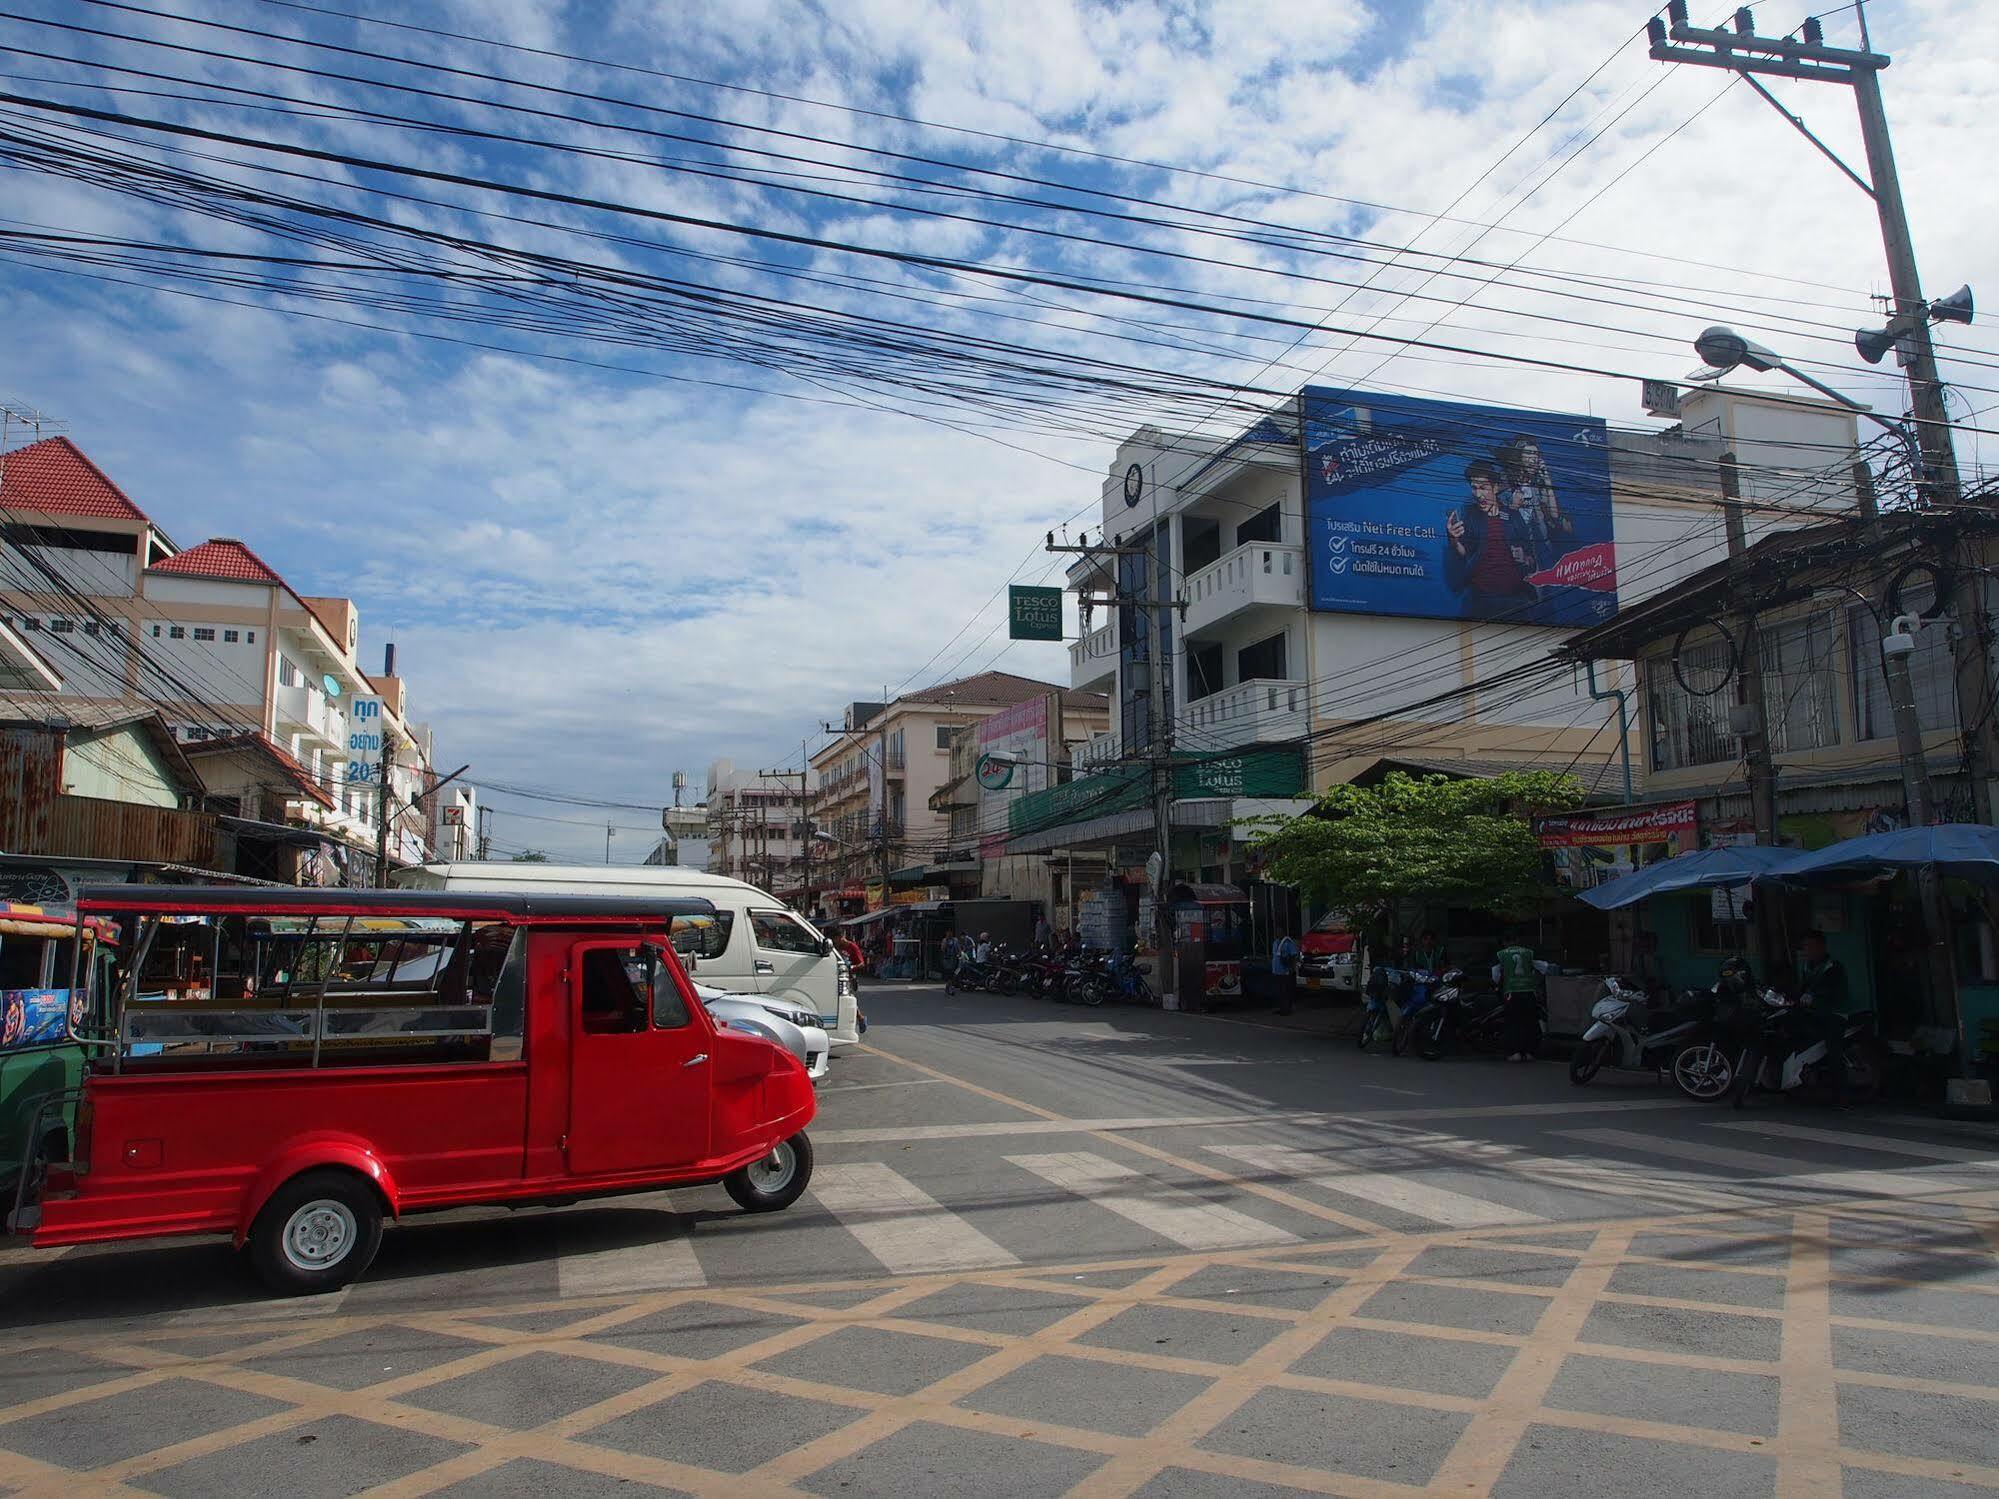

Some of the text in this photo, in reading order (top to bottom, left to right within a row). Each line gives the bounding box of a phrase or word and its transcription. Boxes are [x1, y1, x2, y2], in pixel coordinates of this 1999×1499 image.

[1327, 518, 1436, 539] โปรเสริม Net Free Call
[1351, 541, 1416, 558] โทรฟรี 24 ชั่วโมง
[1014, 596, 1058, 608] TESCO
[1016, 610, 1058, 623] Lotus
[354, 700, 379, 723] ทุก
[350, 729, 379, 751] อย่าง
[348, 760, 370, 782] 20
